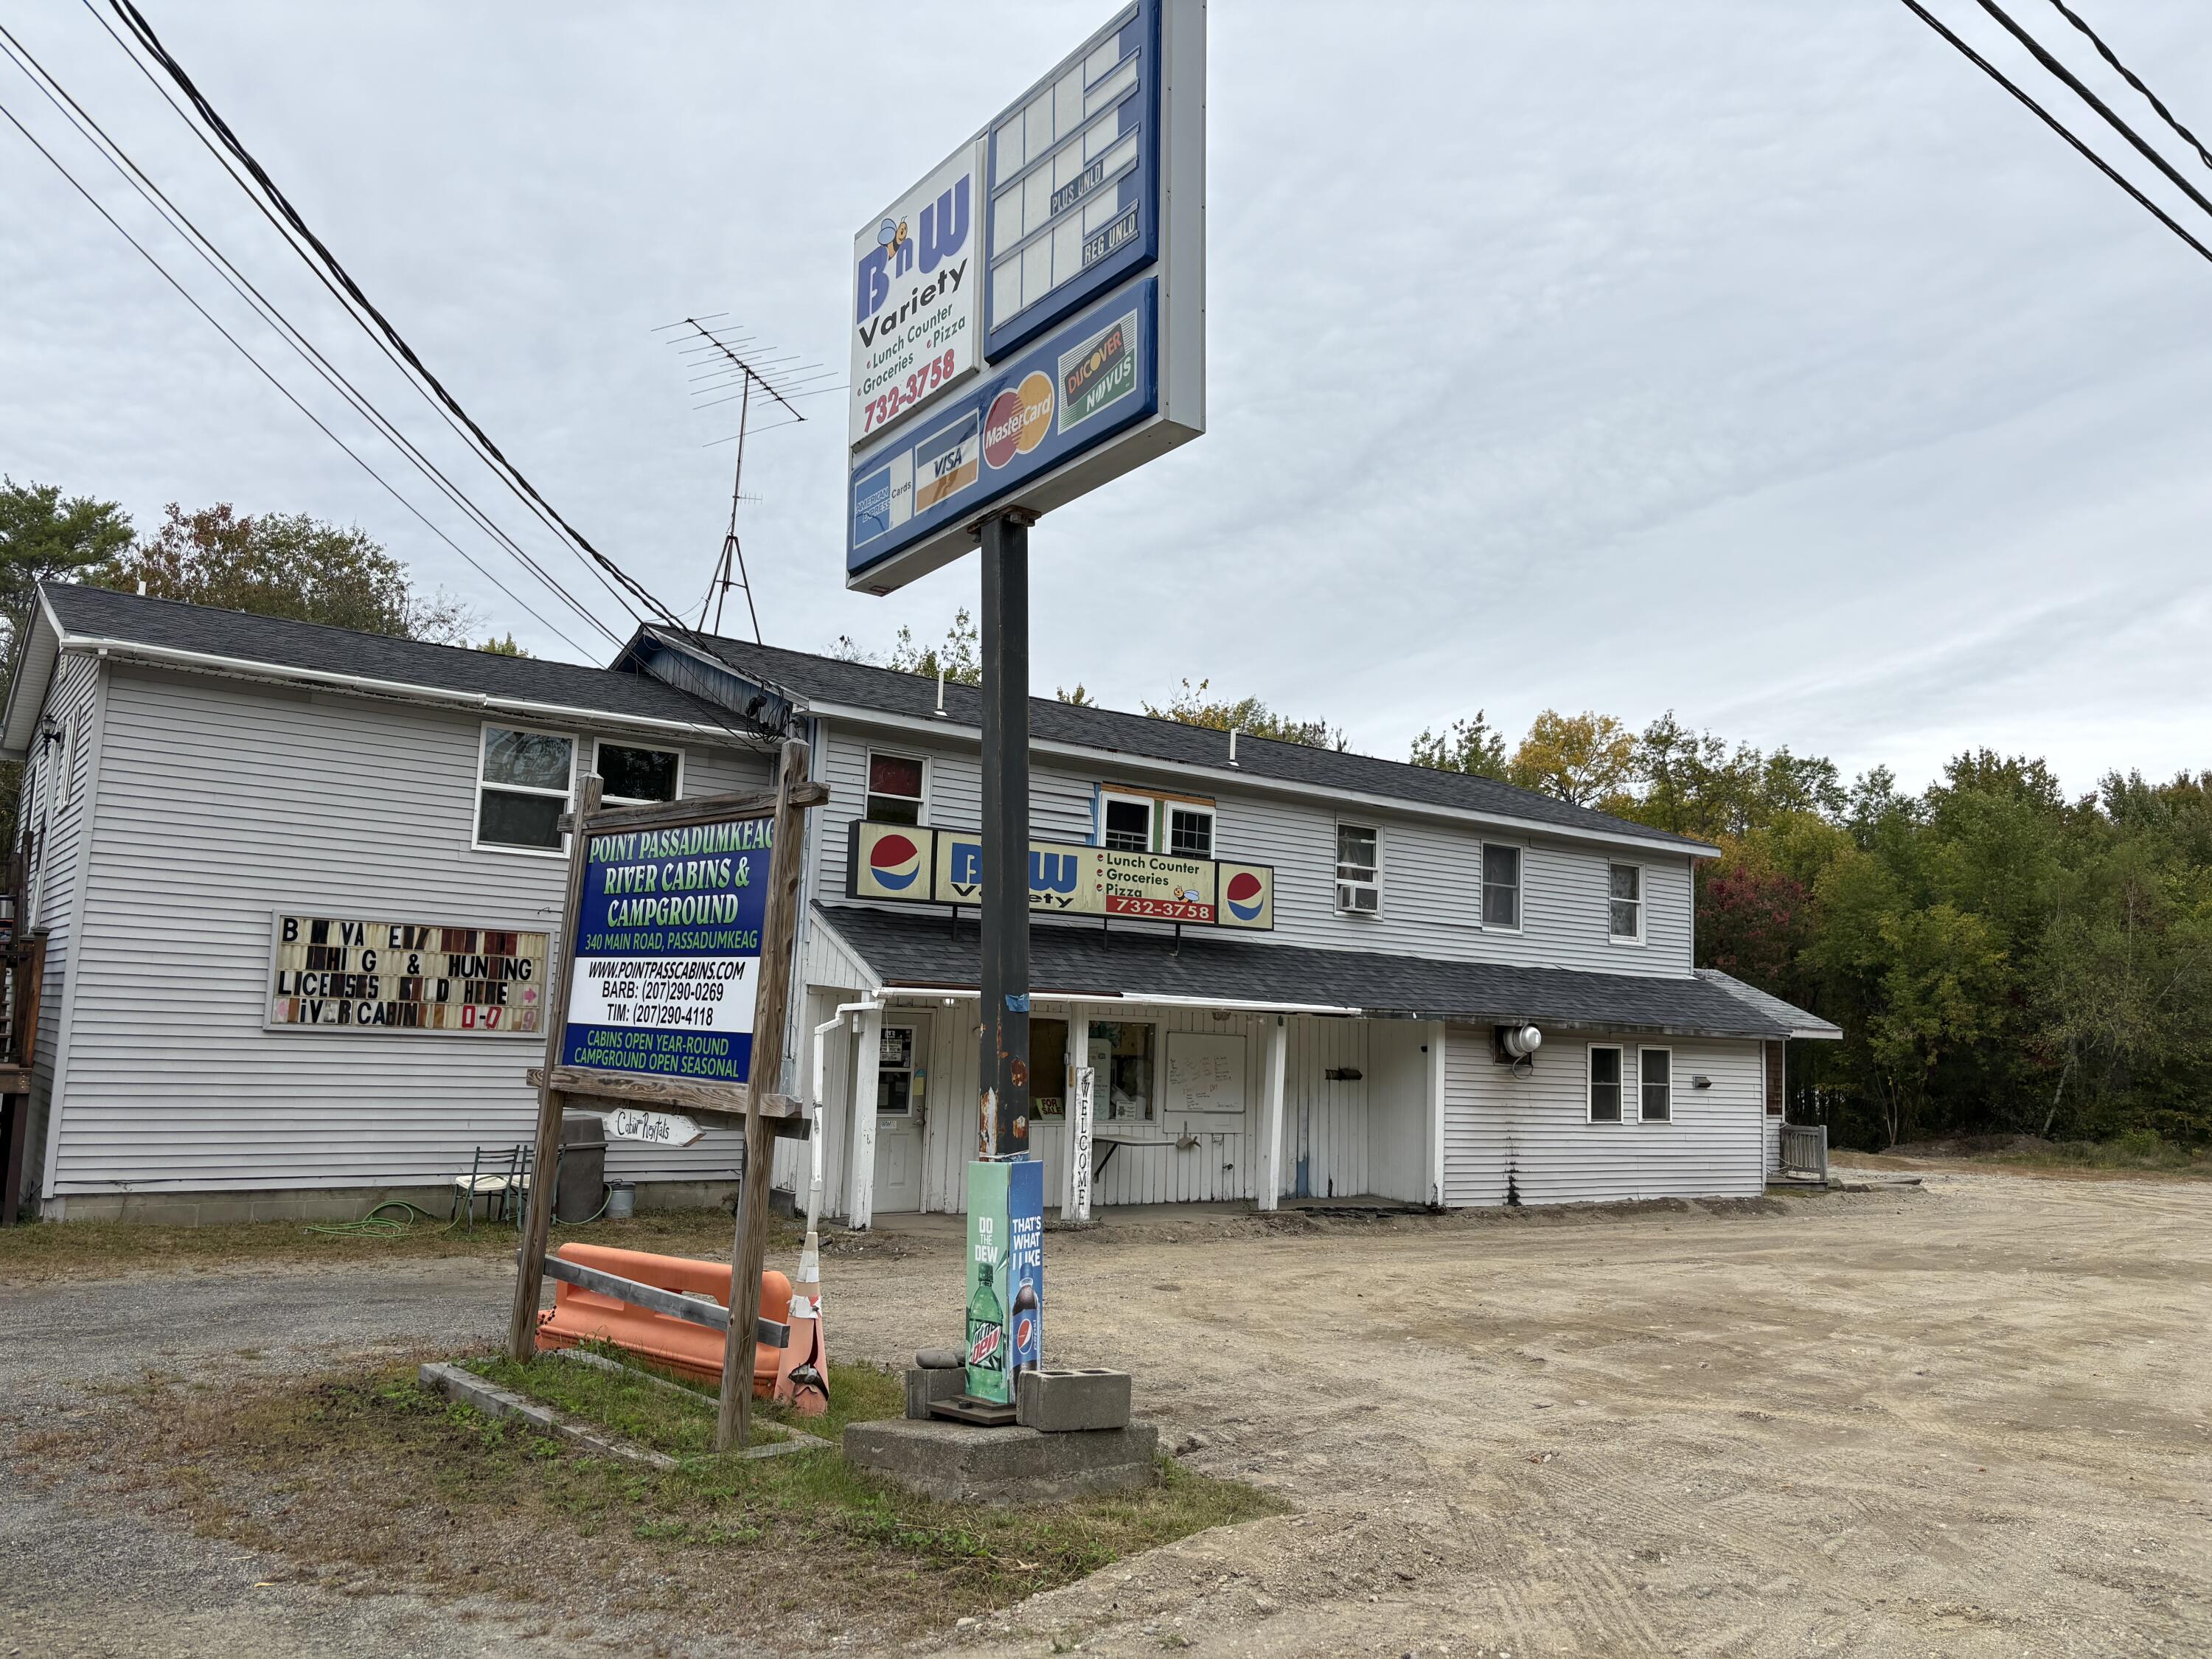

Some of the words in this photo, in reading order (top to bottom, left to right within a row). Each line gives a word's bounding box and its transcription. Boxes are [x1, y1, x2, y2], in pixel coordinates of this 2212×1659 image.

[1052, 184, 1074, 214] PLUS
[1078, 164, 1101, 196] UNLD
[1085, 235, 1105, 264] REG
[1109, 213, 1135, 248] UNLD
[859, 258, 967, 348] Variety
[873, 335, 904, 369] Lunch
[908, 304, 953, 343] Counter
[863, 352, 914, 394] Groceries
[933, 316, 965, 348] Pizza
[864, 348, 955, 433] 732-3758
[985, 393, 1051, 449] MasterCard
[934, 448, 962, 478] VISA
[855, 486, 889, 513] AMERICAN
[891, 481, 911, 498] Cards
[862, 499, 891, 523] EXPRESS
[588, 834, 636, 863] POINT
[604, 865, 658, 894] RIVER
[661, 858, 732, 891] CABINS
[734, 856, 750, 887] &
[1107, 852, 1145, 868] Lunch
[1150, 858, 1200, 874] Counter
[1106, 868, 1169, 886] Groceries
[1106, 883, 1142, 897] Pizza
[608, 894, 739, 928] CAMPGROUND
[1116, 898, 1209, 919] 732-3758
[585, 933, 602, 950] 340
[604, 933, 630, 950] MAIN
[633, 932, 664, 952] ROAD,
[667, 930, 758, 950] PASSADUMKEAG
[407, 953, 420, 975] &
[448, 954, 532, 980] HUNING
[589, 961, 745, 980] WWW.POINTPASSCABINS.COM
[602, 981, 639, 998] BARB:
[642, 980, 723, 1003] (207)290-0269
[608, 1004, 630, 1022] TIM:
[633, 1003, 714, 1026] (207)290-4118
[588, 1030, 622, 1048] CABINS
[625, 1032, 653, 1050] OPEN
[656, 1034, 728, 1056] YEAR-ROUND
[574, 1048, 647, 1069] CAMPGROUND
[649, 1053, 678, 1071] OPEN
[681, 1056, 739, 1077] SEASONAL
[1041, 1098, 1057, 1107] FOR
[1042, 1105, 1062, 1115] SALE
[618, 1111, 639, 1135] Cabin
[642, 1113, 669, 1141] Rentals
[1078, 1082, 1090, 1206] WELCOME
[979, 1217, 993, 1234] DO
[1012, 1216, 1041, 1233] THAT'S
[980, 1234, 992, 1245] THE
[1013, 1231, 1040, 1250] WHAT
[975, 1245, 998, 1263] DEW
[1012, 1253, 1016, 1270] I
